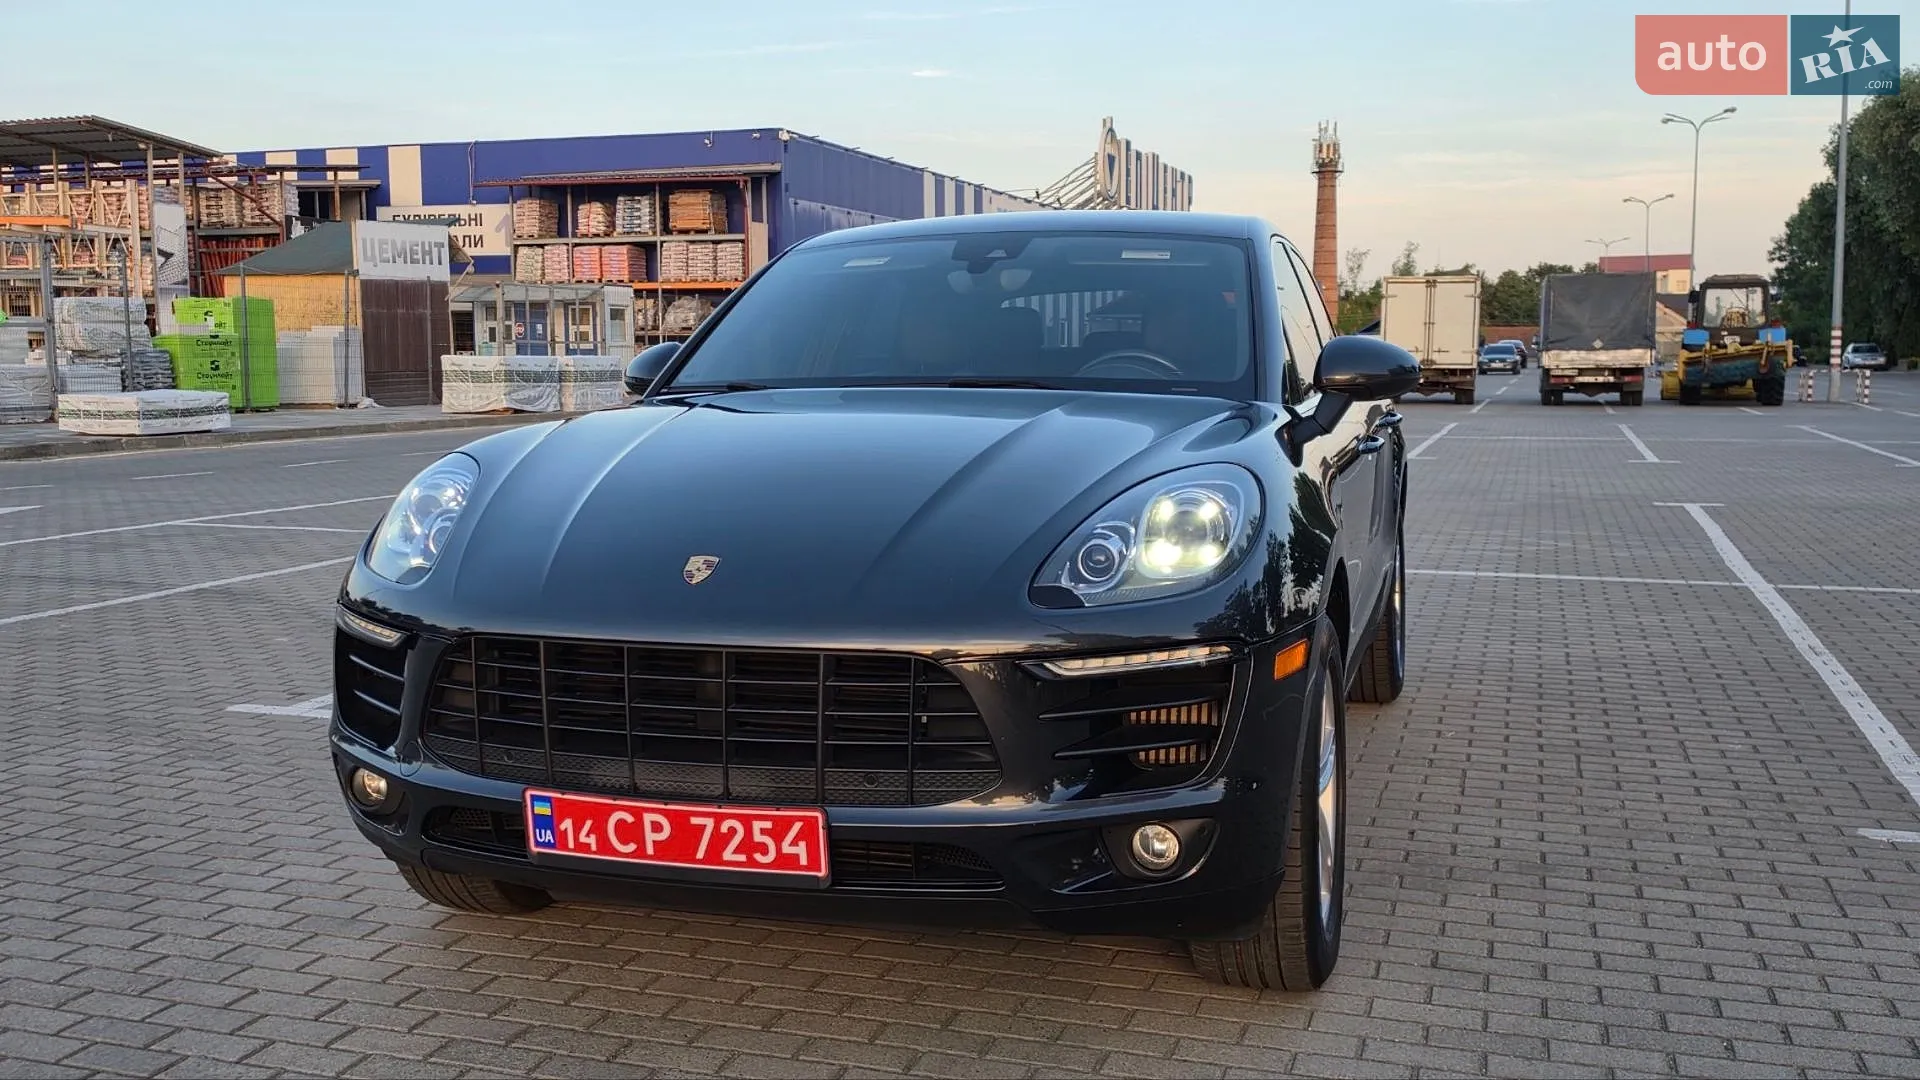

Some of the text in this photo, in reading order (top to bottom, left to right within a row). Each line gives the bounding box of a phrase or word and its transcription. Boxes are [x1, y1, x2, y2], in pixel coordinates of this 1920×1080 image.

[361, 236, 445, 267] ЦЕМЕНТ
[536, 828, 554, 844] UA
[558, 810, 808, 866] 14 CP 7254
